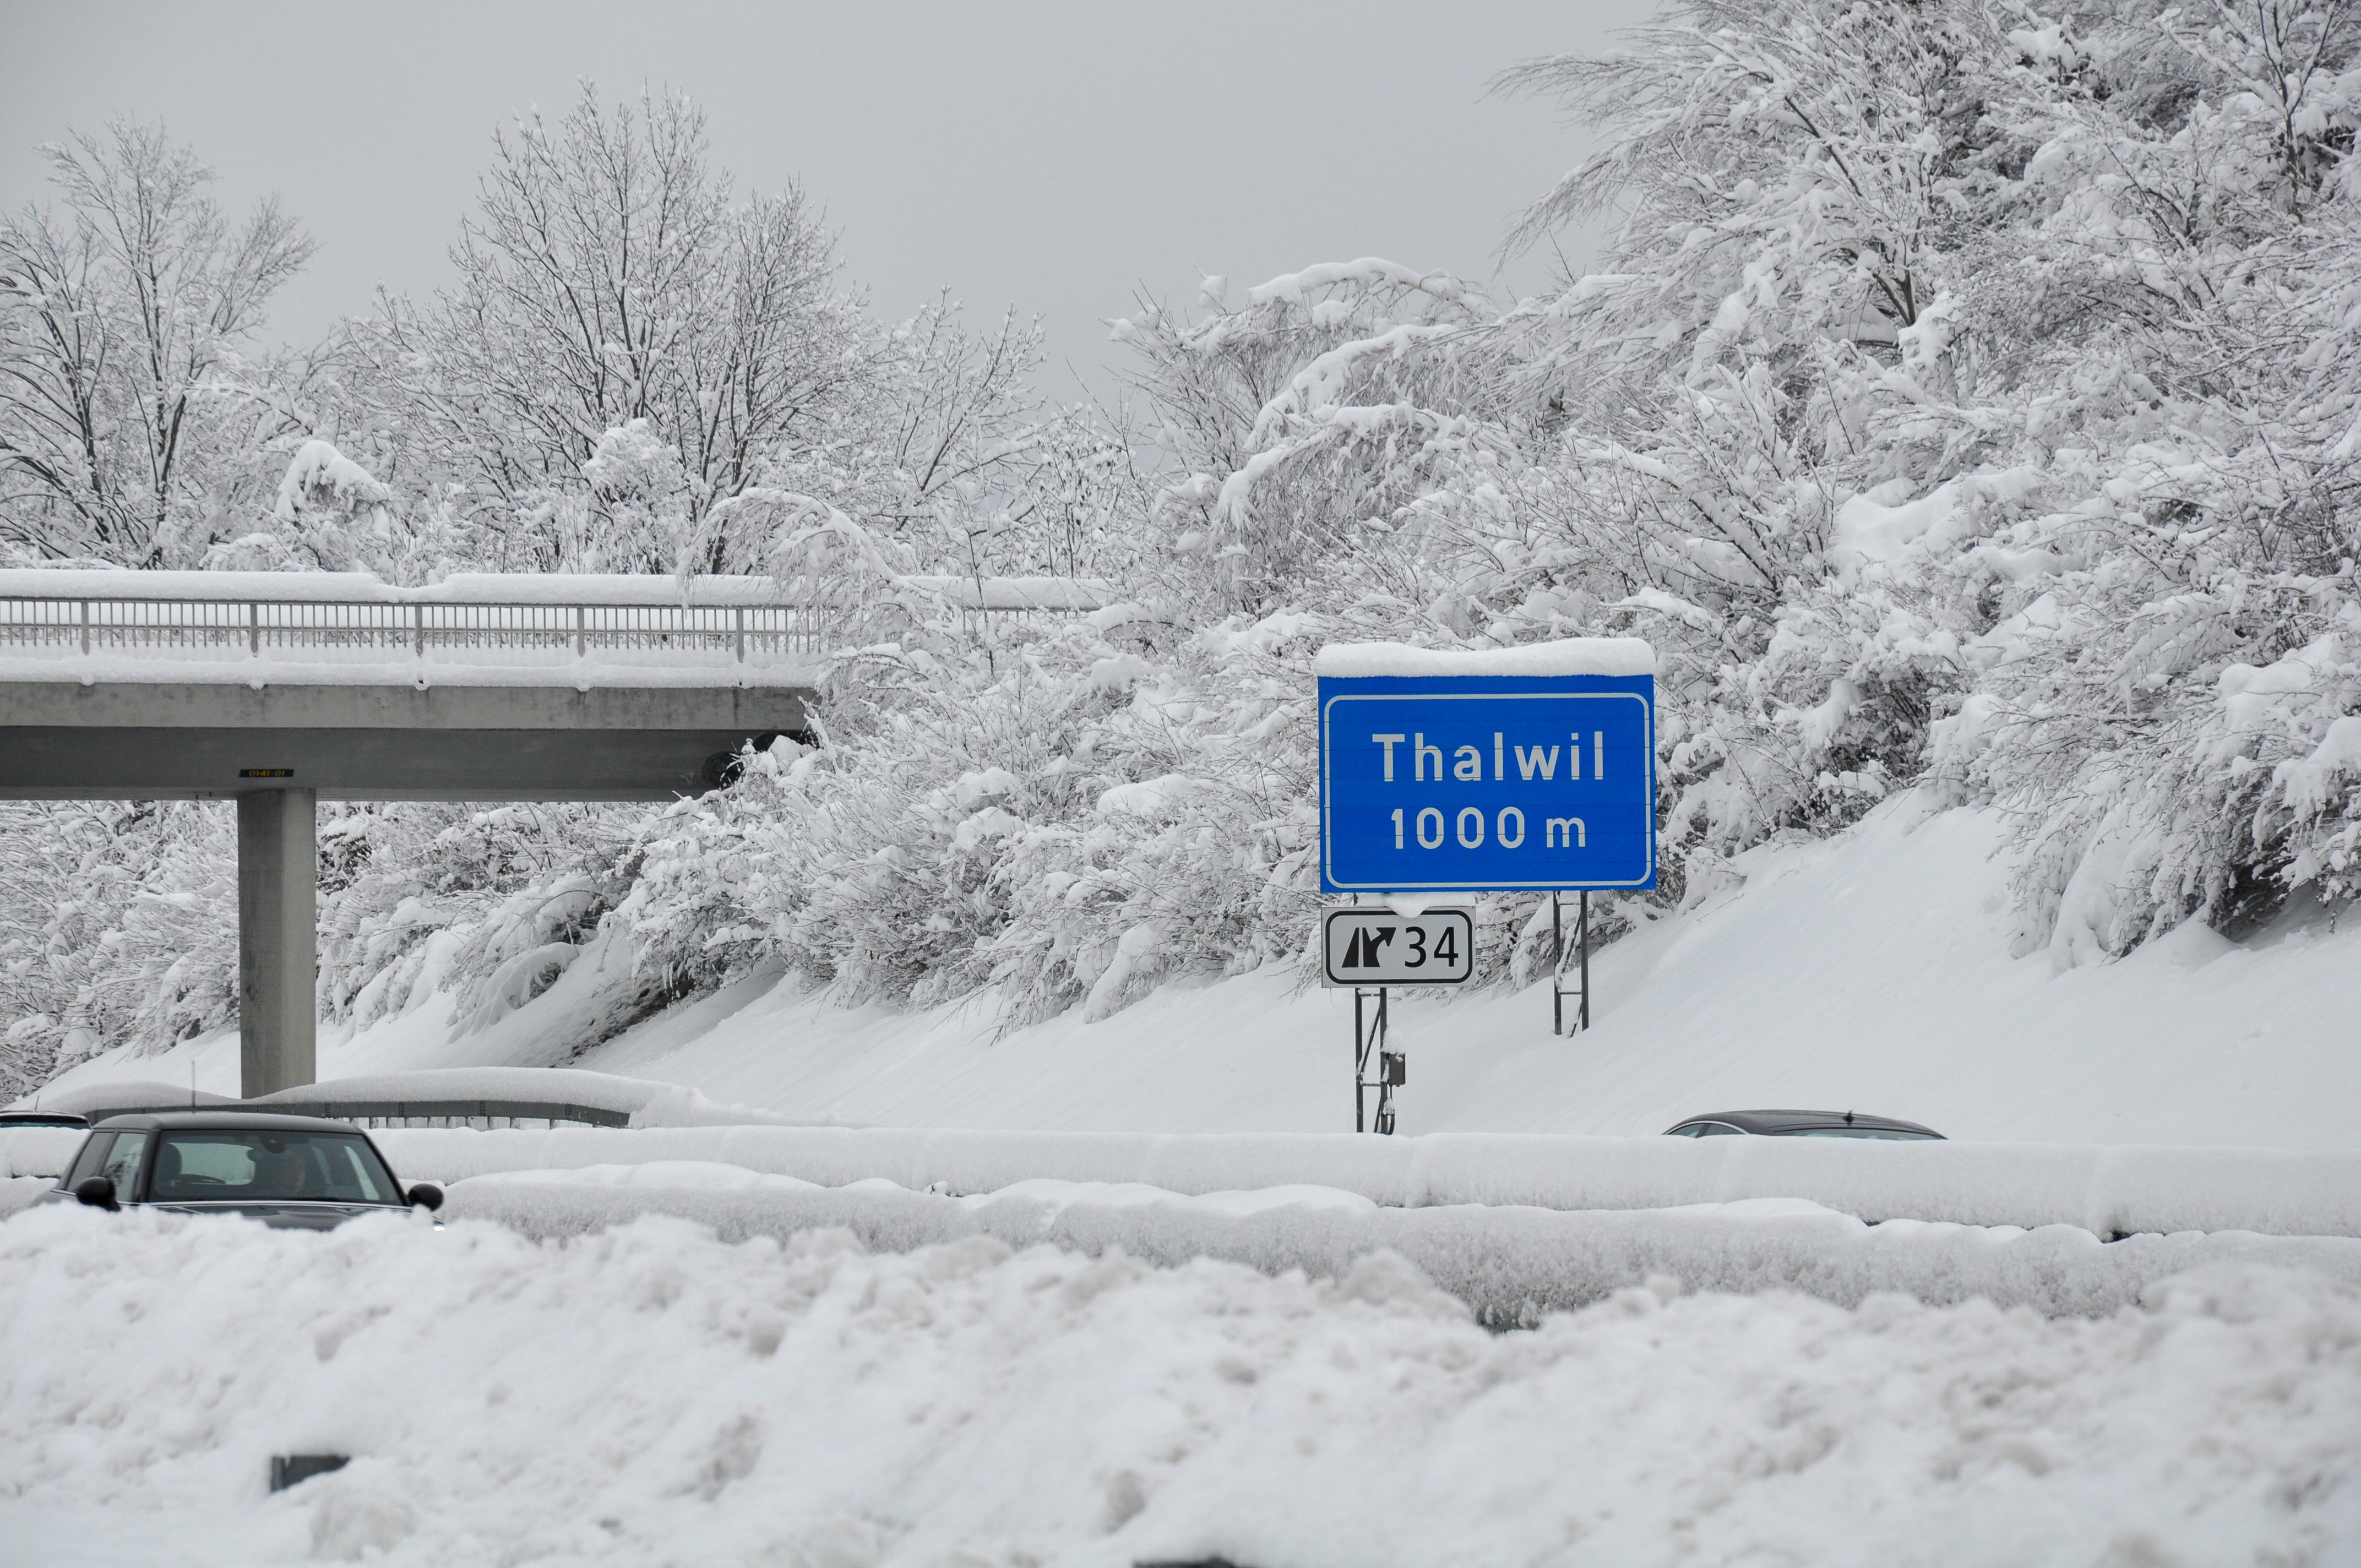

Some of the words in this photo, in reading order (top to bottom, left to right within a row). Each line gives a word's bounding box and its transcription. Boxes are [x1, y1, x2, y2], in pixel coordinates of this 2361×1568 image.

[1372, 731, 1604, 781] Thalwil
[1391, 807, 1525, 849] 1000
[1546, 818, 1586, 848] m
[1405, 926, 1459, 968] 34
